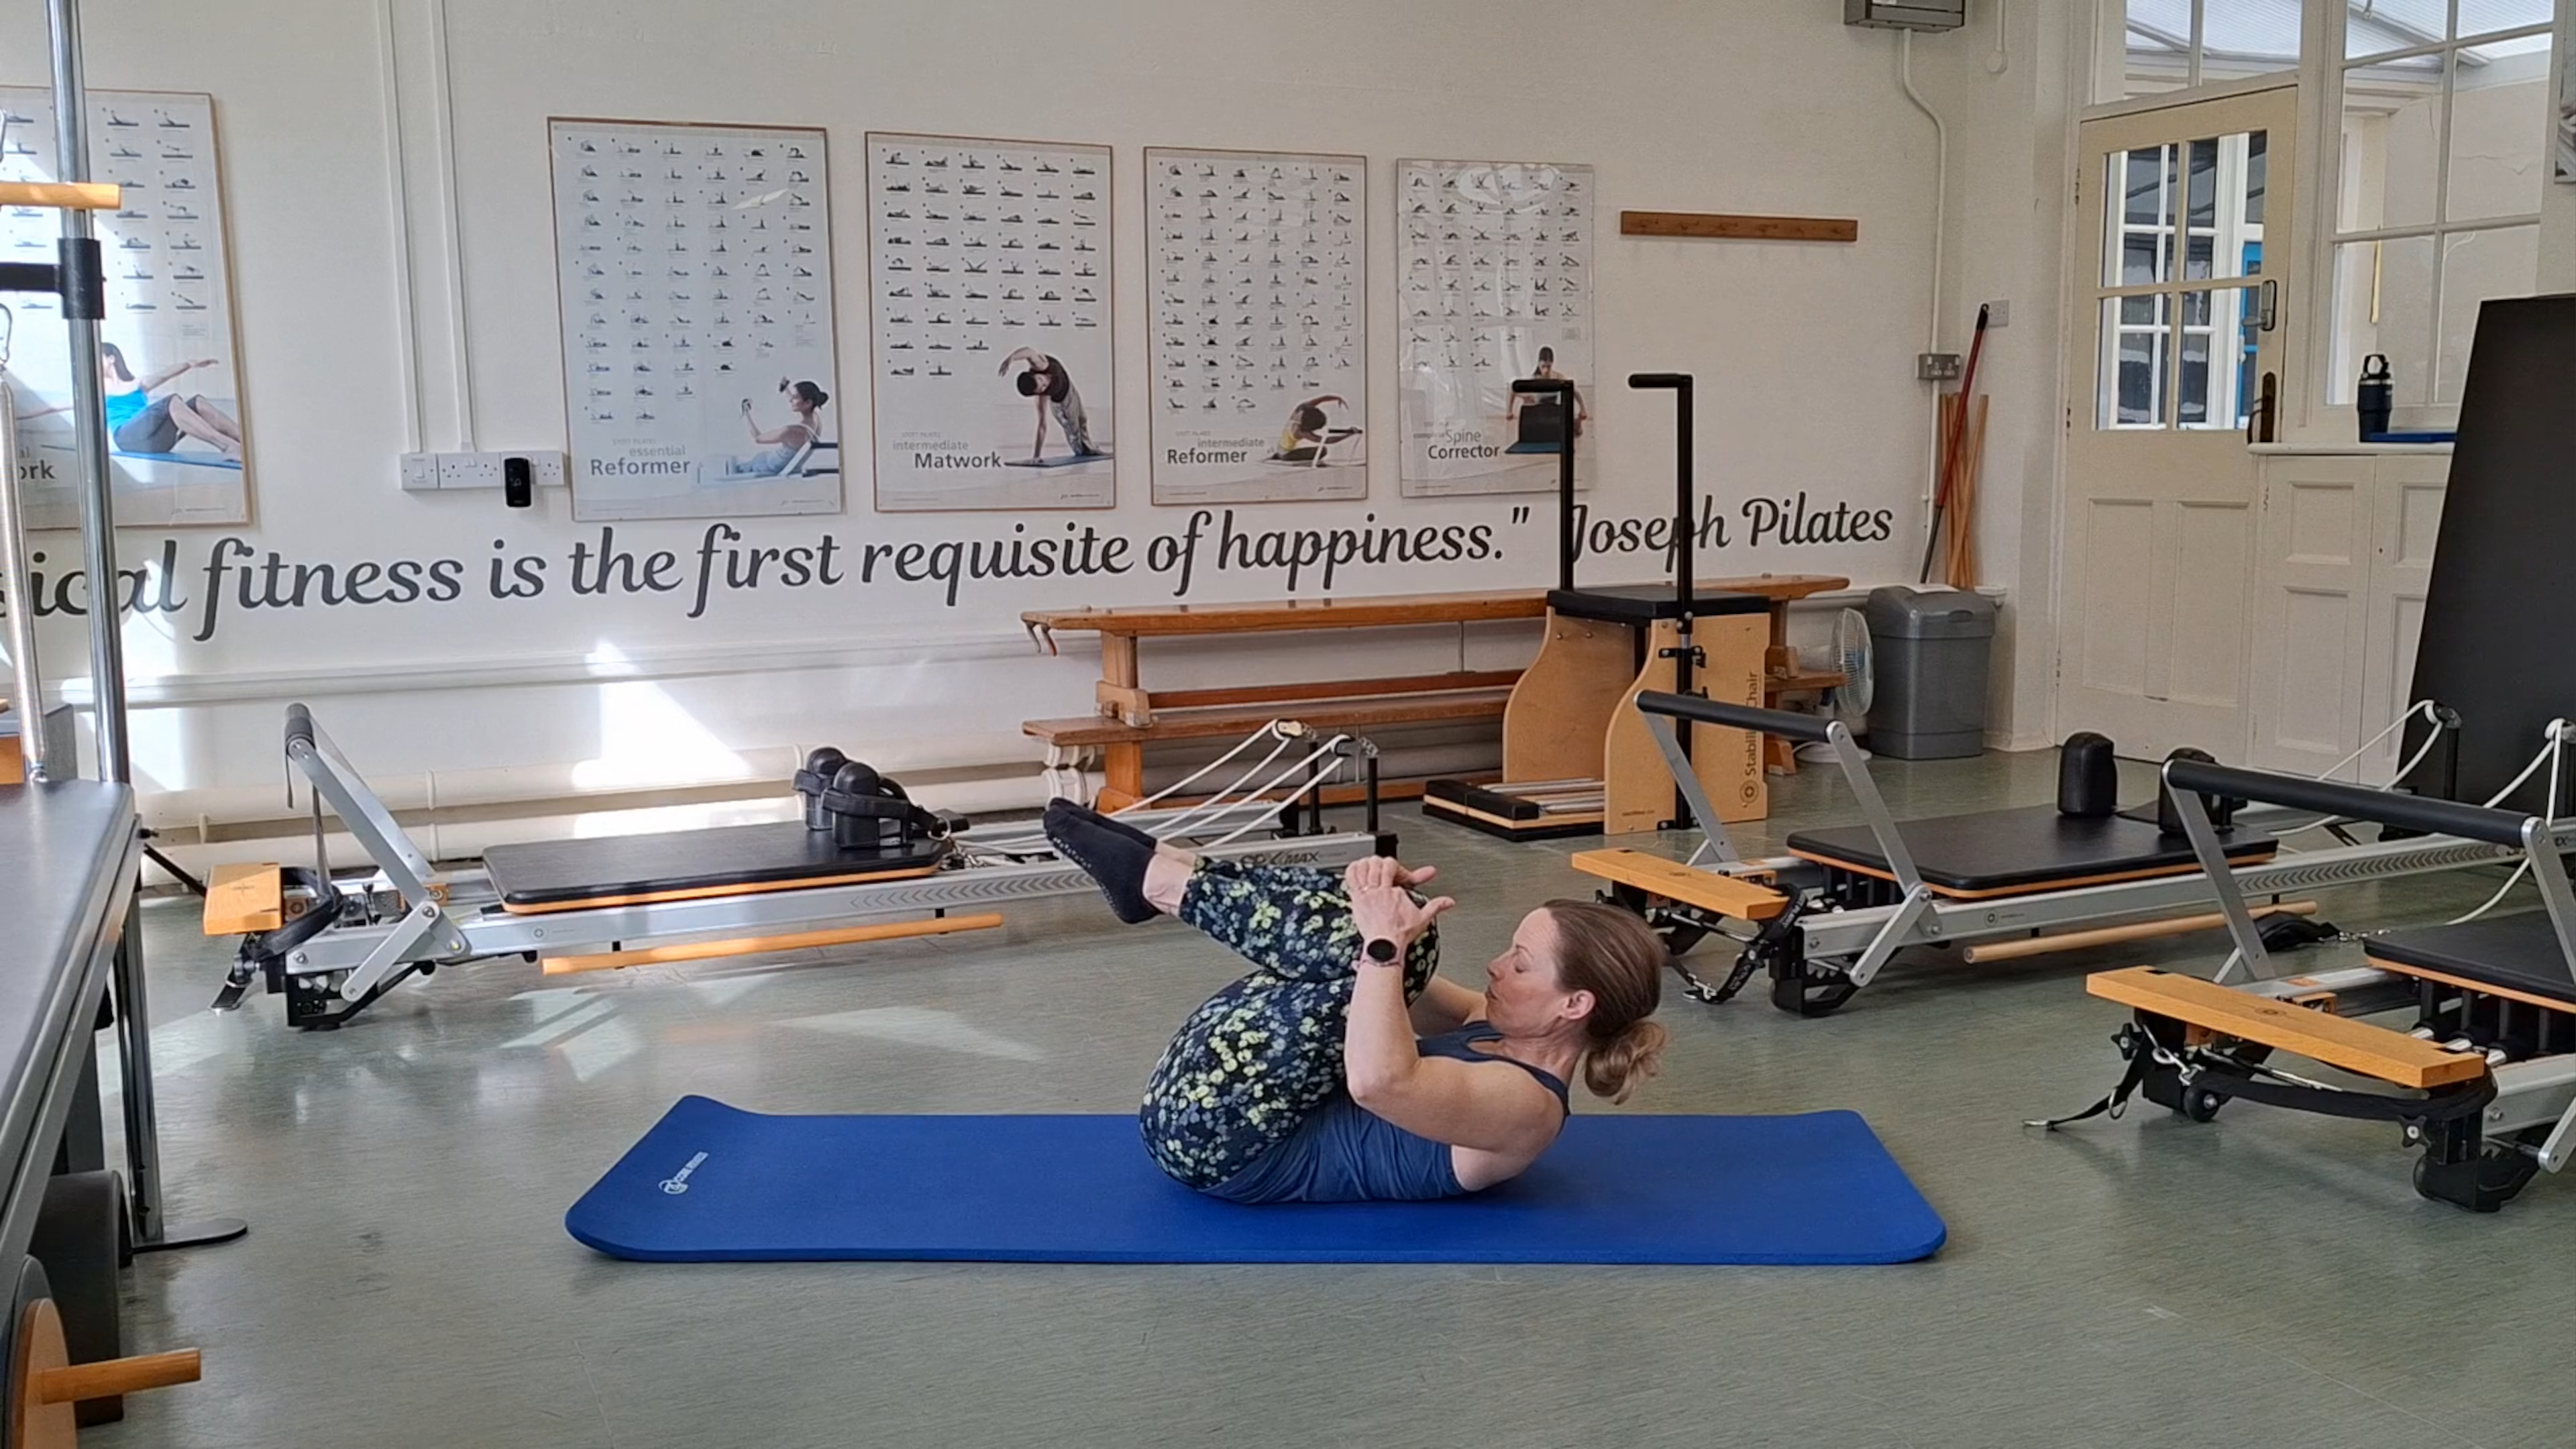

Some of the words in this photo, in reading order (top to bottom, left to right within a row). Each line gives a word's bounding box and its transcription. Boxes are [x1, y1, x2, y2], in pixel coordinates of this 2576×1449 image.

[893, 439, 969, 451] intermediate
[1197, 437, 1265, 448] intermediate
[1446, 429, 1481, 446] Spine
[629, 444, 686, 457] essential
[1167, 447, 1247, 464] Reformer
[1428, 444, 1500, 459] Corrector
[590, 457, 691, 476] Reformer
[914, 451, 1002, 469] Matwork
[1742, 491, 1893, 547] Pilates
[0, 539, 188, 616] ical
[193, 537, 464, 641] fitness
[490, 539, 547, 598] is
[568, 526, 684, 594] the
[686, 523, 845, 618] first
[861, 521, 1134, 606] requisite
[1147, 511, 1212, 596] of
[1745, 731, 1756, 776] Stabili
